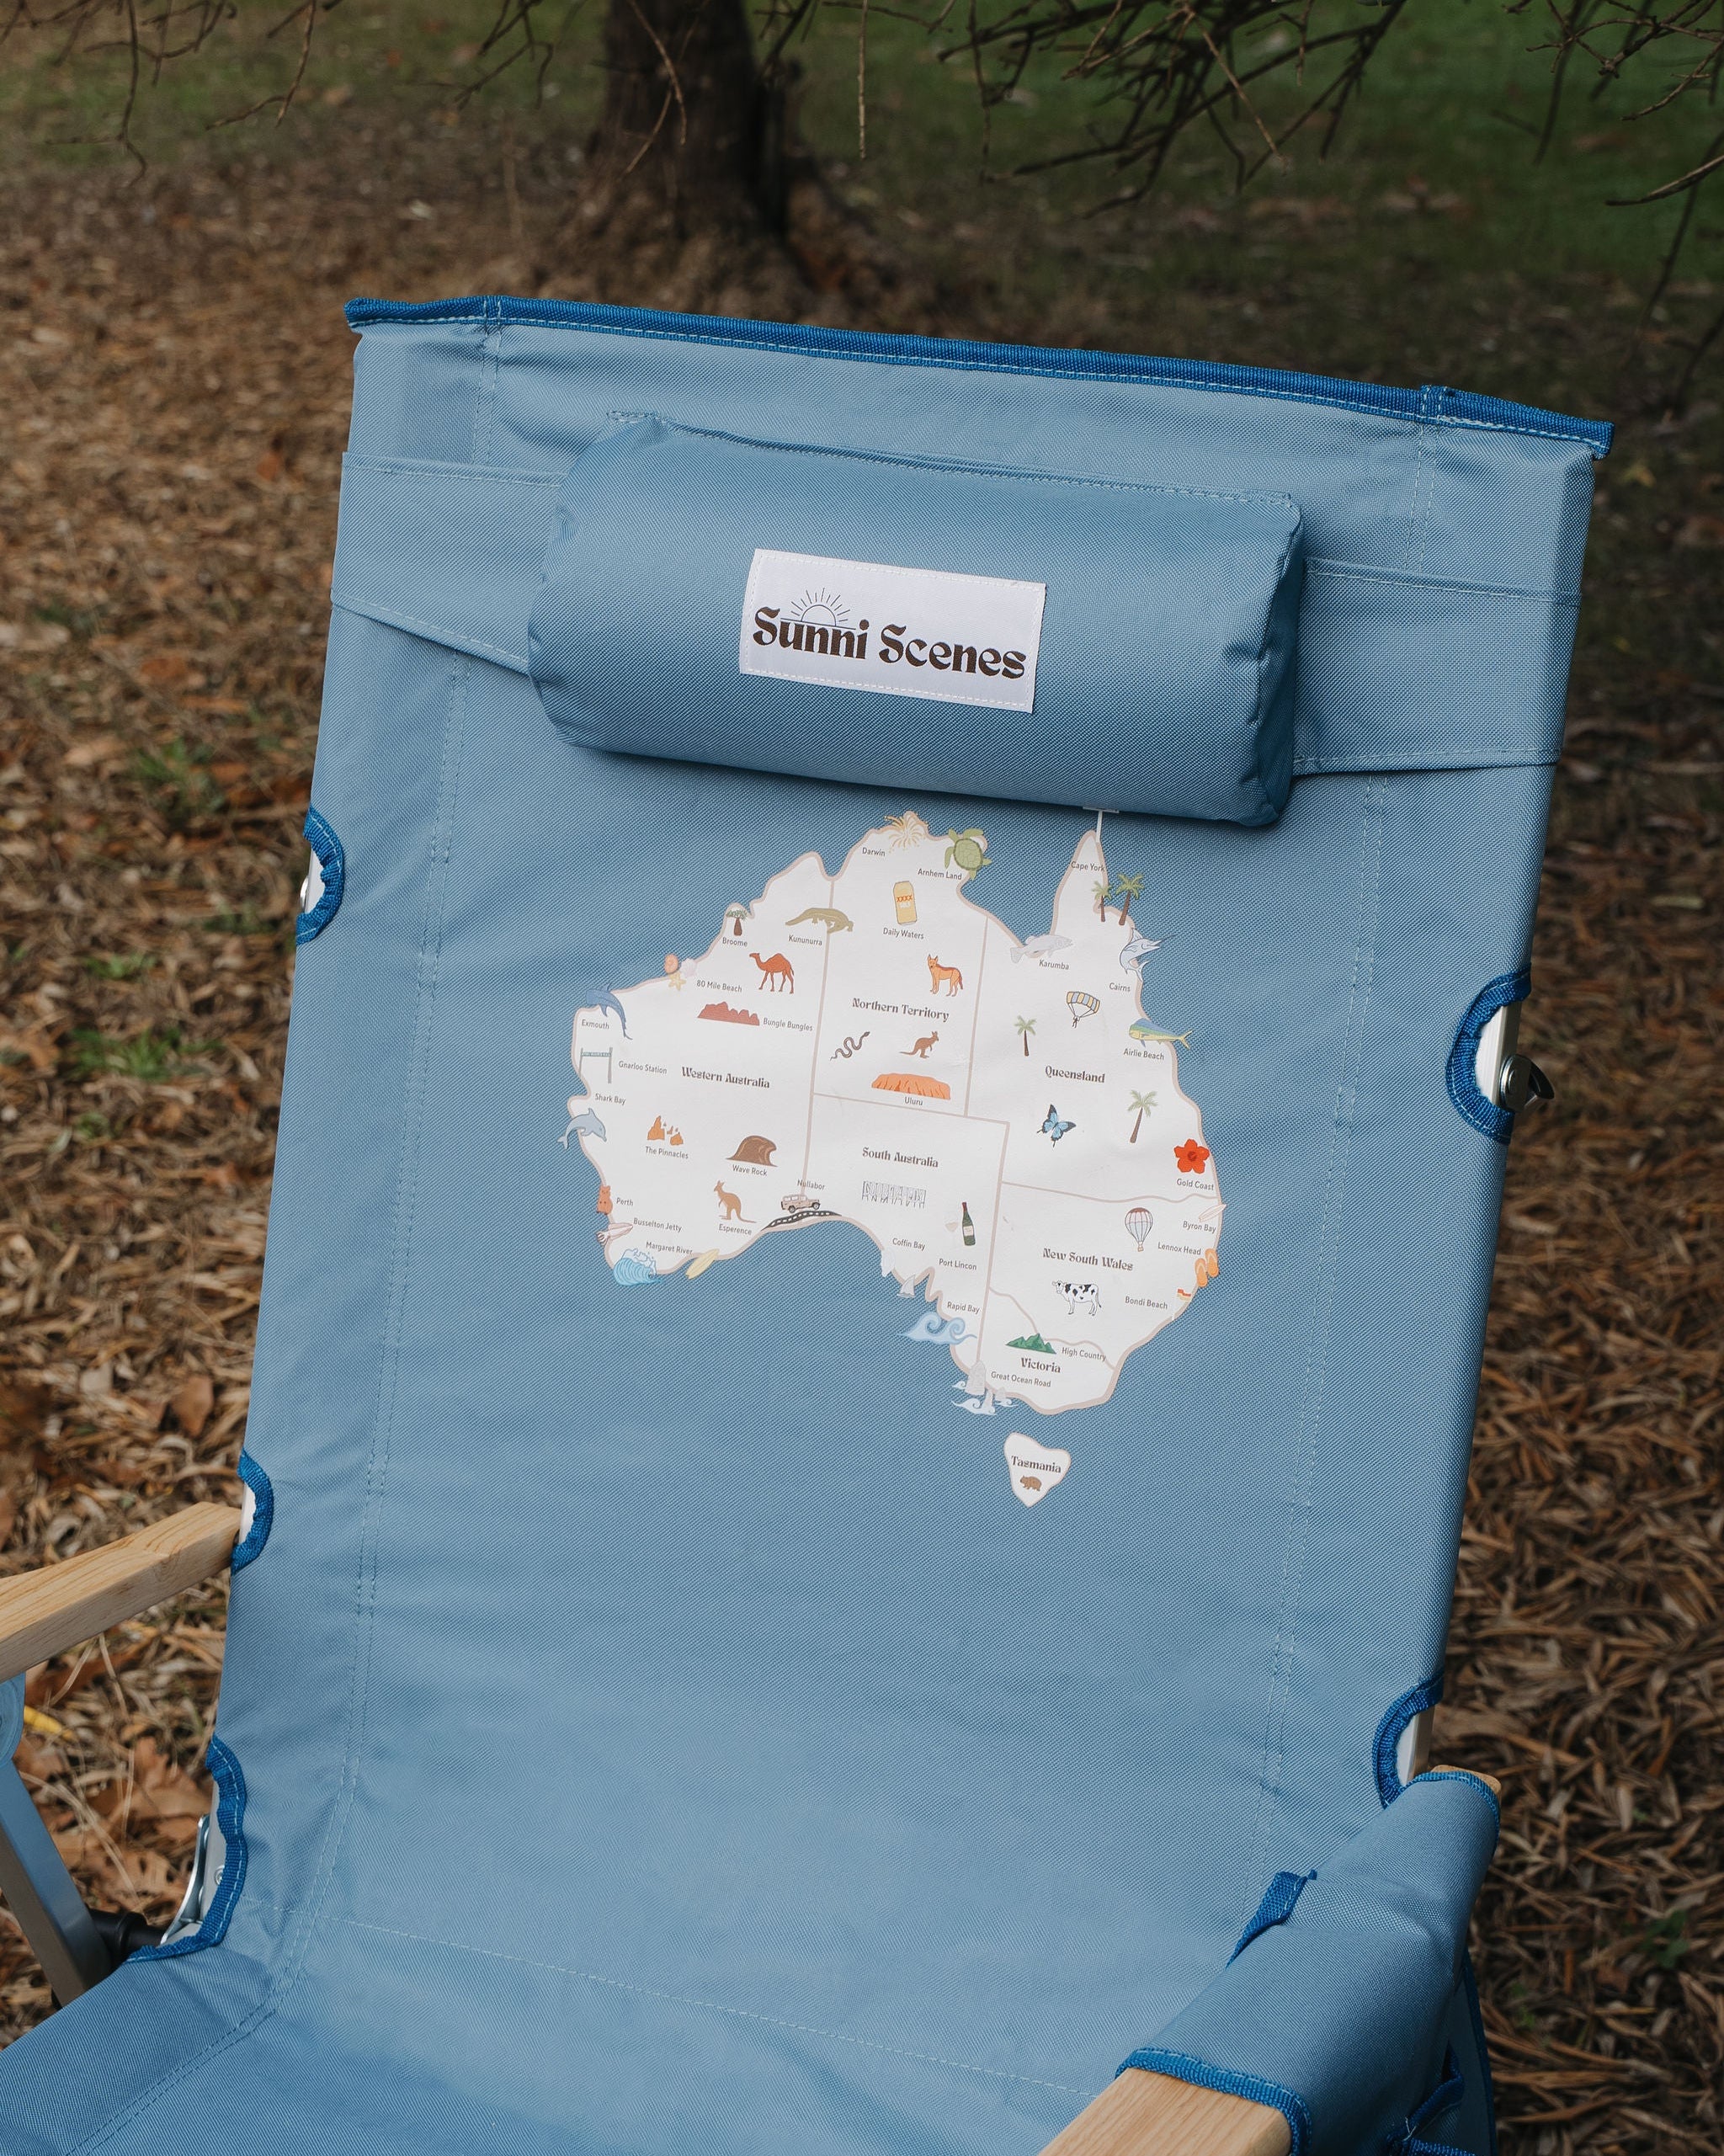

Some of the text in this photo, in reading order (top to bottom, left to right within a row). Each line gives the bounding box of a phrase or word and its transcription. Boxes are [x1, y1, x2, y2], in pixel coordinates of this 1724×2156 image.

[753, 606, 1028, 680] Sunni Scenes
[862, 847, 886, 857] Darwin
[1071, 860, 1105, 872] Cape York
[918, 868, 962, 881] Arnhem Land
[789, 934, 822, 946] Kununurra
[883, 927, 924, 940] Daily Waters
[722, 937, 748, 947] Broome
[1039, 959, 1070, 971] Karumba
[696, 979, 742, 993] 80 Mile Beach
[1109, 982, 1131, 993] Cairns
[852, 997, 950, 1023] Northern Territory
[581, 1019, 609, 1030] Exmouth
[764, 1017, 813, 1032] Bungle Bungles
[1123, 1047, 1165, 1061] Airlie Beach
[619, 1060, 668, 1074] Gnarloo Station
[682, 1066, 770, 1089] Western Australia
[1045, 1065, 1105, 1083] Queensland
[595, 1093, 626, 1106] Shark Bay
[904, 1096, 923, 1106] Uluru
[645, 1146, 689, 1160] The Pinnacles
[862, 1147, 939, 1168] South Australia
[732, 1164, 768, 1177] Wave Rock
[797, 1179, 825, 1191] Nullabor
[1176, 1178, 1214, 1190] Gold Coast
[616, 1197, 633, 1206] Perth
[633, 1217, 682, 1232] Busselton Jetty
[718, 1223, 752, 1236] Esperence
[1183, 1221, 1216, 1234] Byron Bay
[646, 1241, 693, 1254] Margaret River
[892, 1238, 926, 1252] Coffin Bay
[1157, 1242, 1201, 1255] Lennox Head
[939, 1259, 977, 1270] Port Lincon
[1042, 1247, 1134, 1271] New South Wales
[947, 1302, 980, 1314] Rapid Bay
[1125, 1296, 1168, 1310] Bondi Beach
[1062, 1347, 1107, 1362] High Country
[1020, 1357, 1062, 1374] Victoria
[991, 1371, 1051, 1387] Great Ocean Road
[1011, 1456, 1062, 1473] Tasmania
